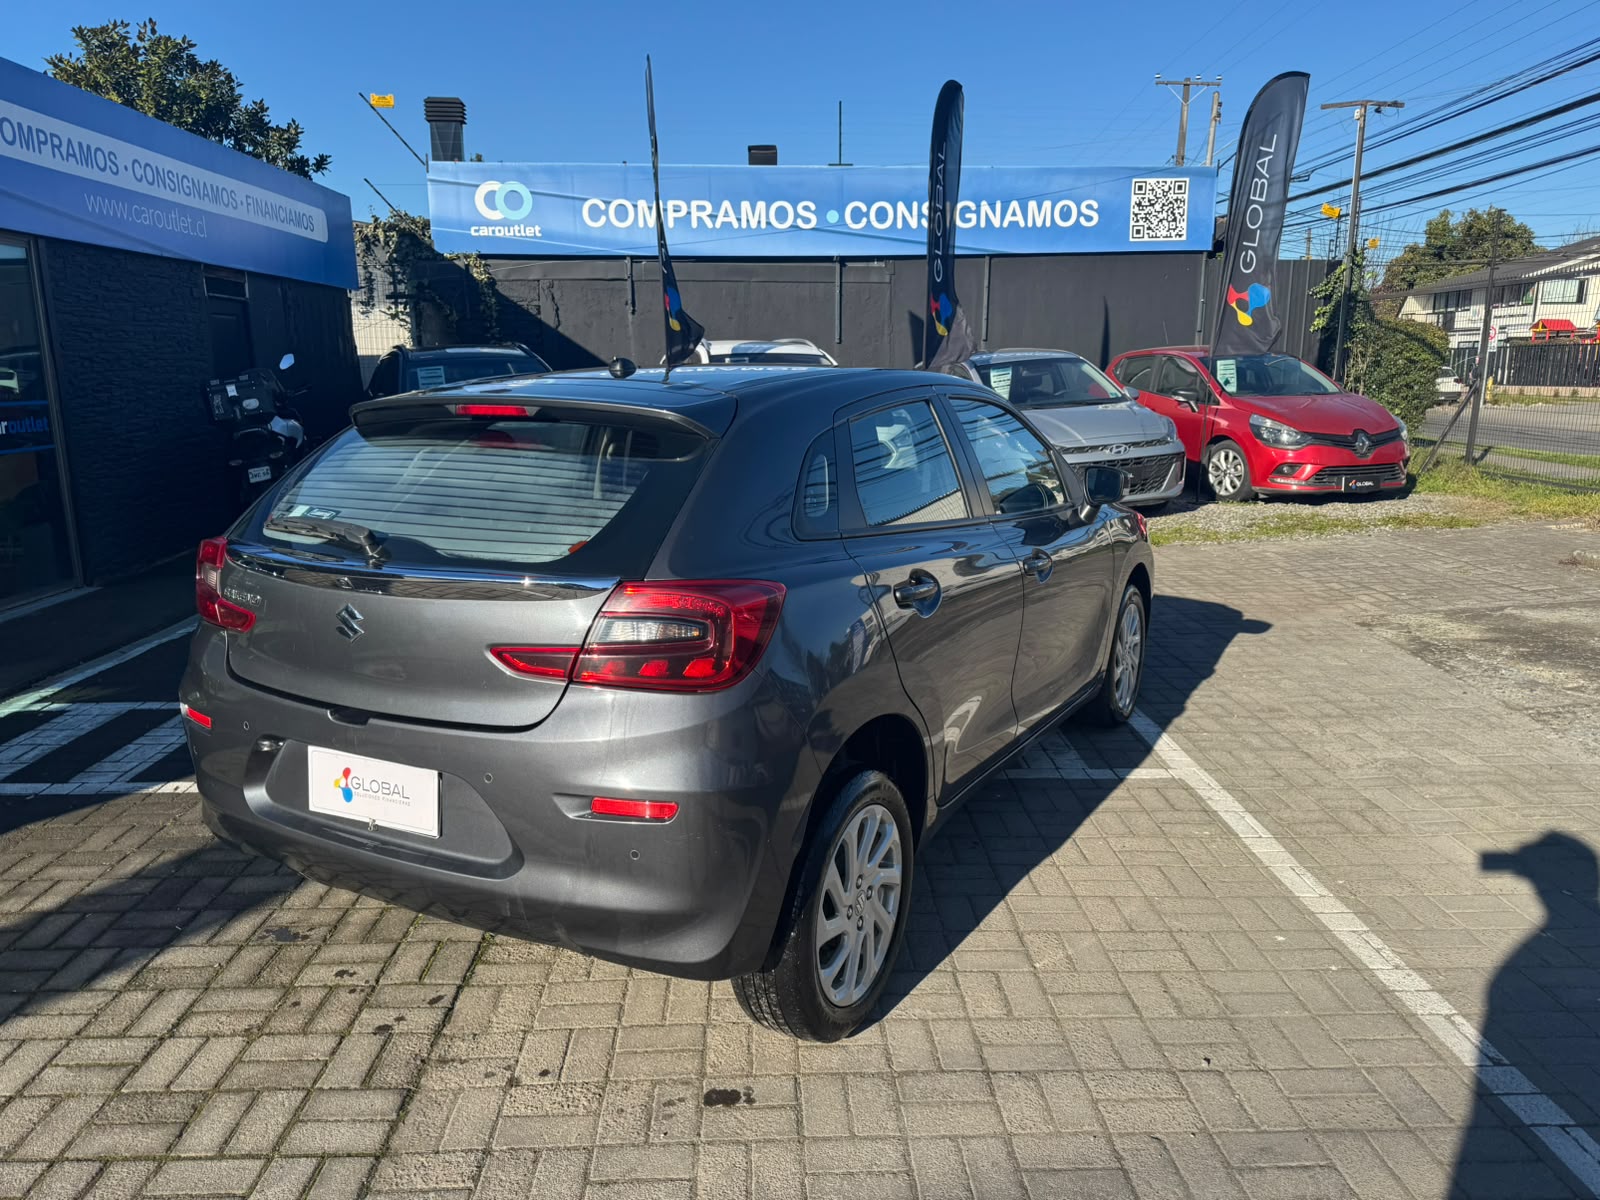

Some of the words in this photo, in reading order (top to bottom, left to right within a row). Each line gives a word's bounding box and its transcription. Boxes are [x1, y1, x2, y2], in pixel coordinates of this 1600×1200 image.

[84, 192, 207, 239] www.caroutlet.cl
[131, 158, 239, 210] CONSIGNAMOS
[245, 194, 315, 233] FINANCIAMOS
[582, 198, 818, 230] COMPRAMOS
[933, 142, 946, 283] GLOBAL
[1239, 133, 1278, 274] GLOBAL
[470, 223, 543, 238] caroutlet
[351, 776, 410, 799] GLOBAL
